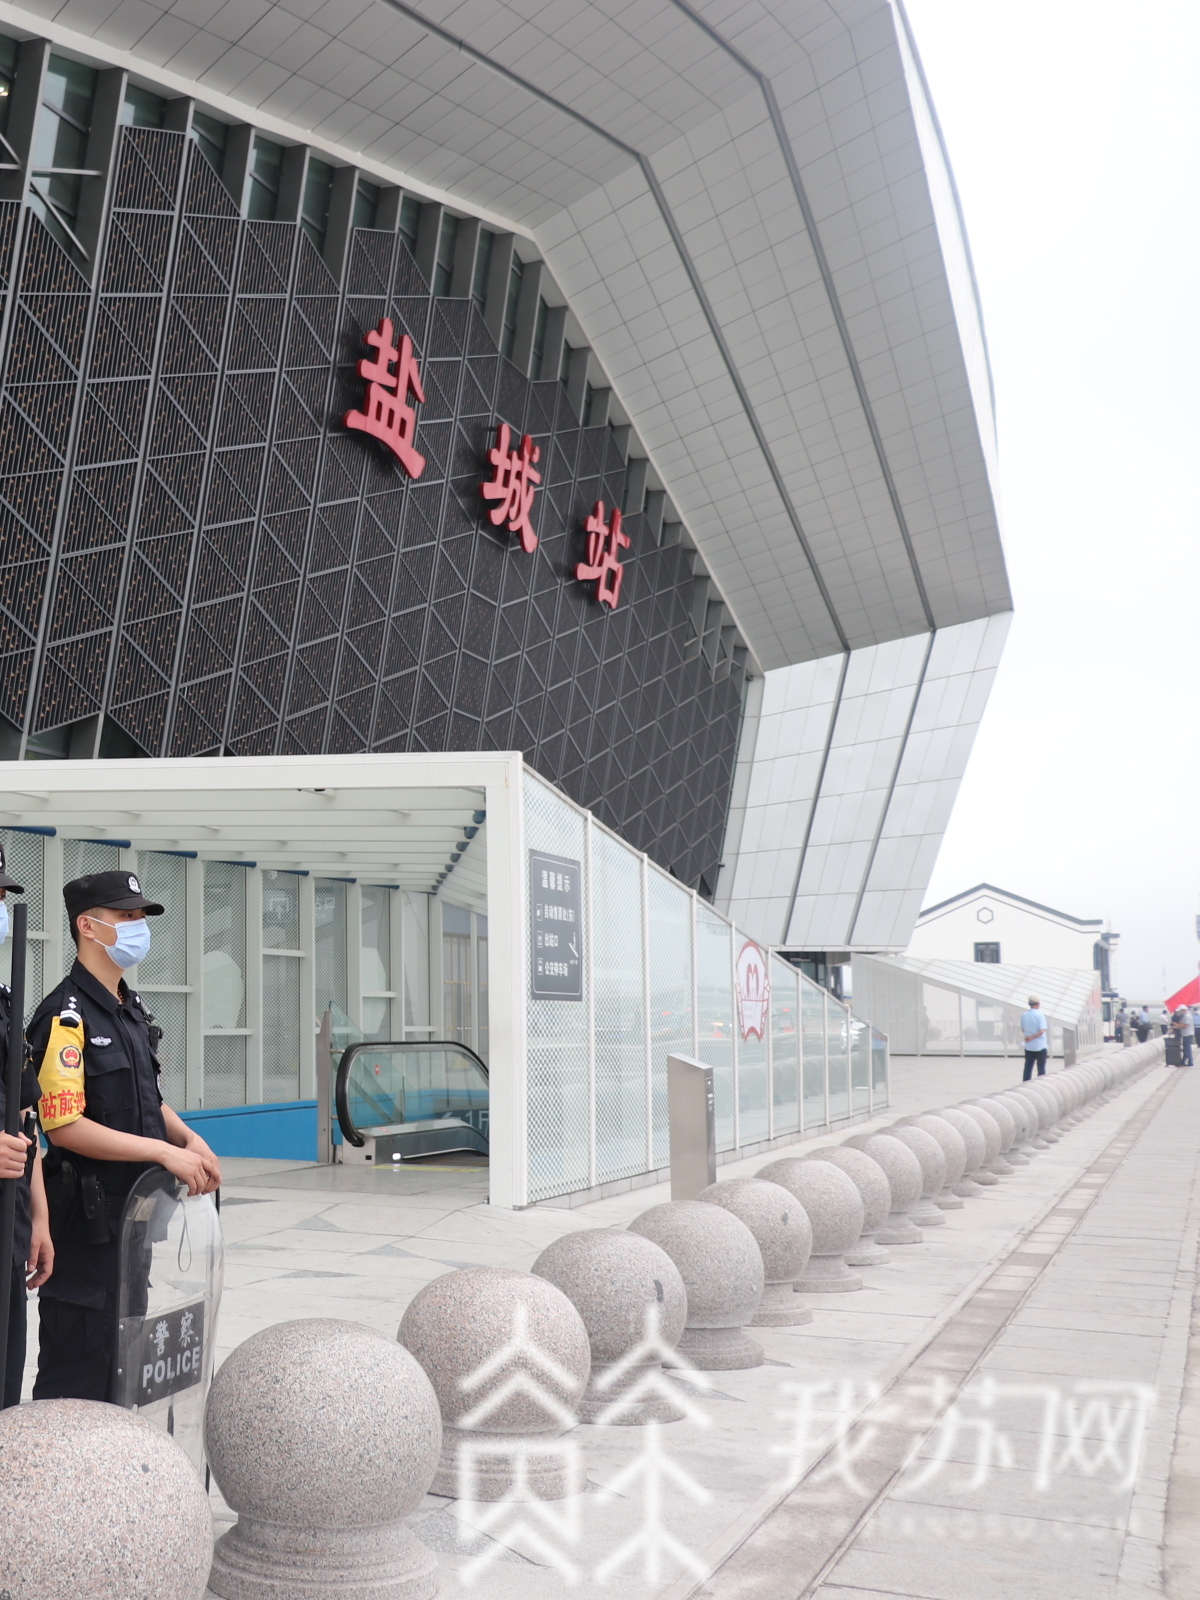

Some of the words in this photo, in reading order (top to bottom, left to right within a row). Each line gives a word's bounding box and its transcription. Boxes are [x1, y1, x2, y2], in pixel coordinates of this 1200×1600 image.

[343, 317, 631, 609] 盐城站
[153, 1311, 195, 1357] 警察
[142, 1346, 201, 1389] POLICE
